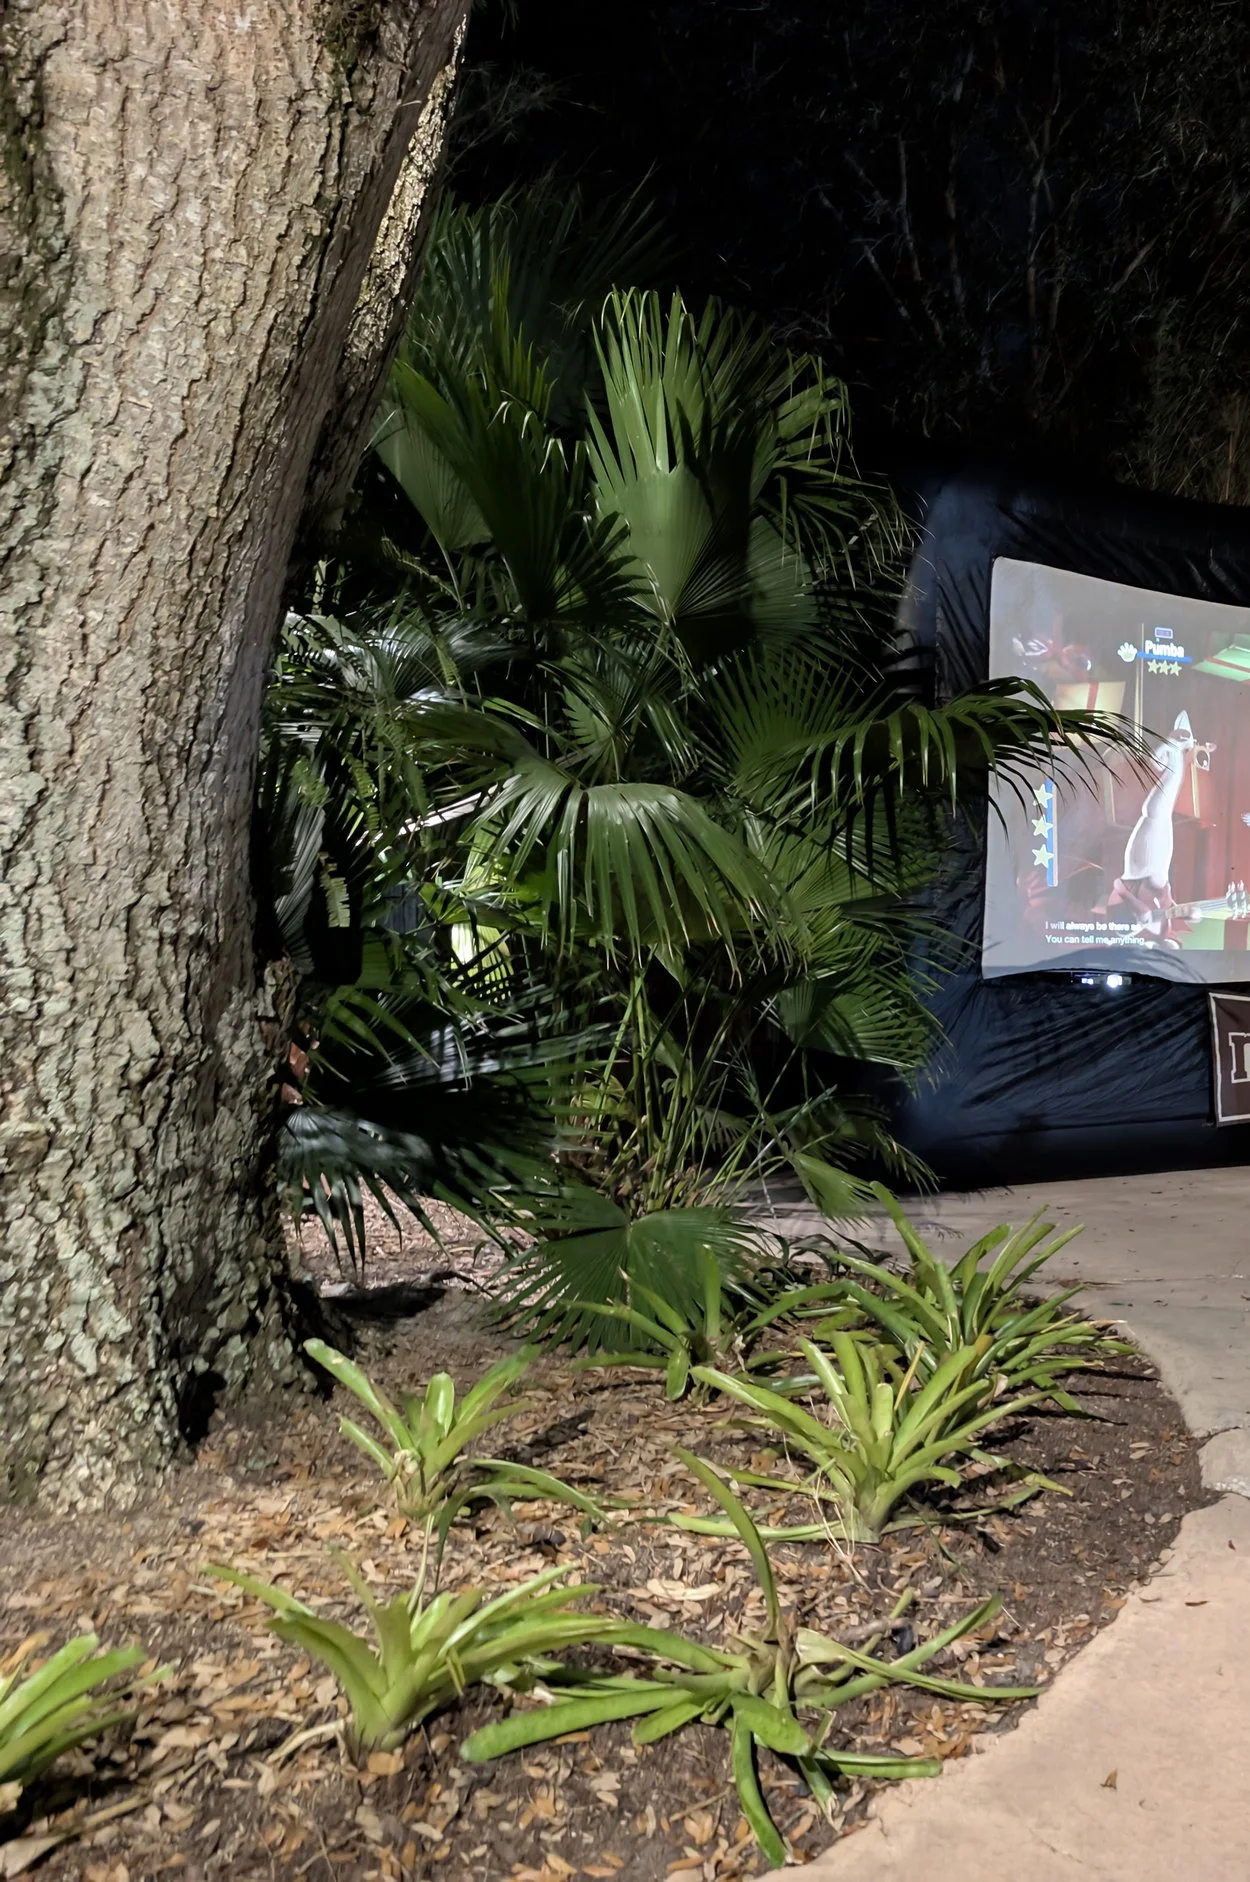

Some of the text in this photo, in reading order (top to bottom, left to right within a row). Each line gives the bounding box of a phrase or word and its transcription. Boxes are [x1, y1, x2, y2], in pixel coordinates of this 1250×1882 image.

[1144, 639, 1185, 658] Pumba
[1050, 921, 1065, 930] will
[1066, 922, 1095, 932] always
[1096, 921, 1108, 931] be
[1109, 921, 1130, 931] there
[1045, 934, 1145, 946] You can tell me anything
